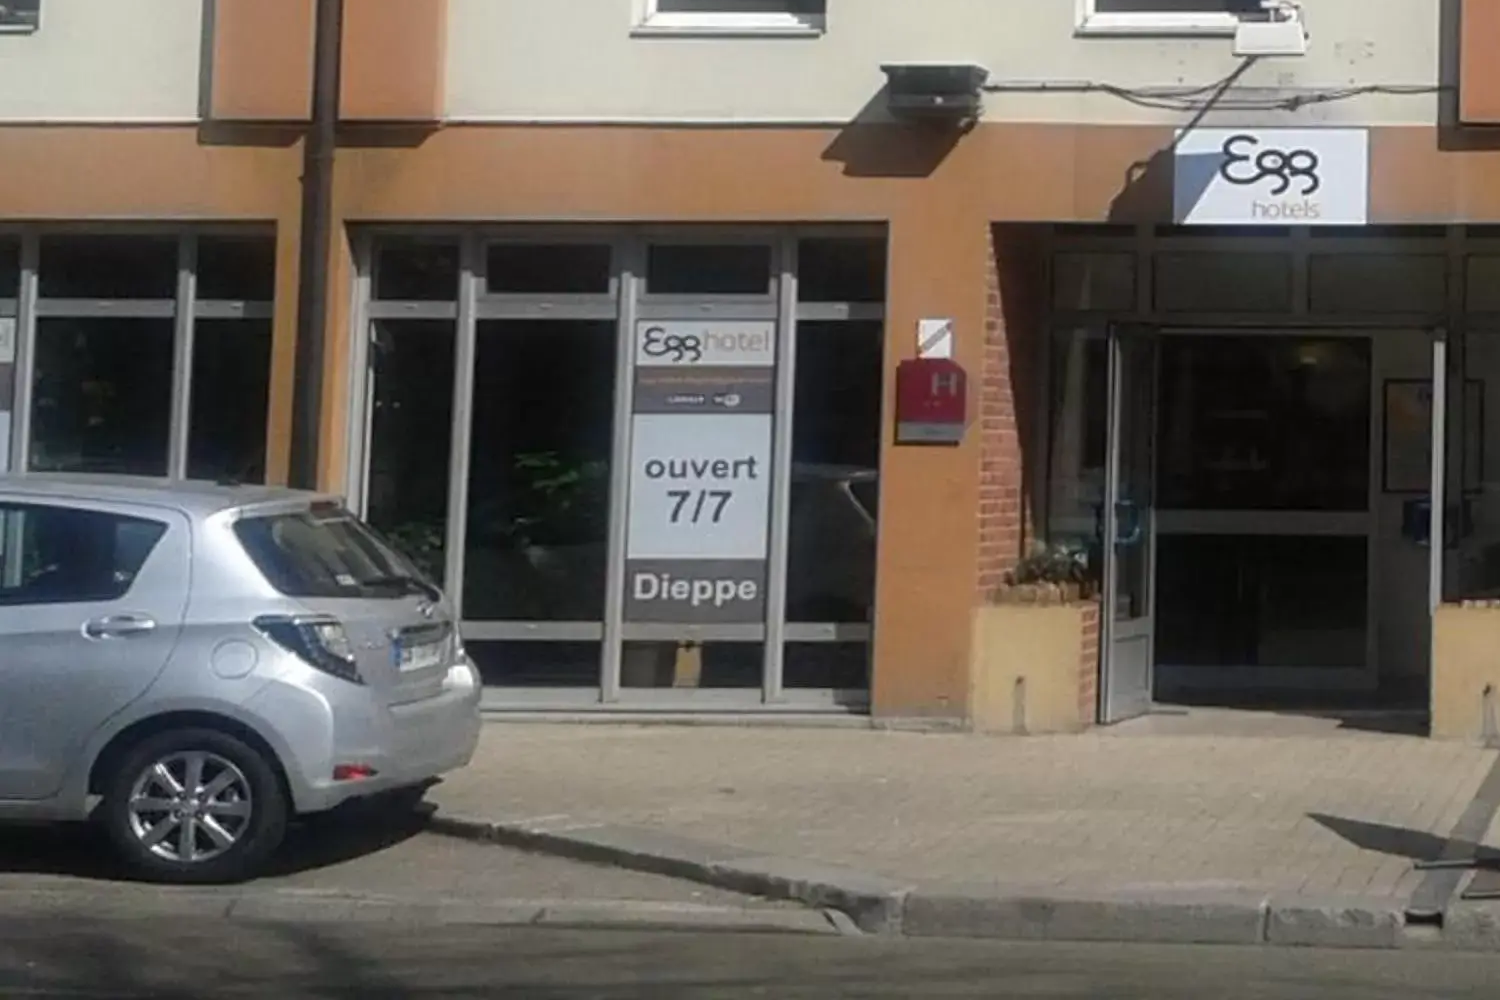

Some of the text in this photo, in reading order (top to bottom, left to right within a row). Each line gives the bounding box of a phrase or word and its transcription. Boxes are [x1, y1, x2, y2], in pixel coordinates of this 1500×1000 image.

[1220, 134, 1319, 195] Egg
[1252, 201, 1320, 219] hotels
[932, 372, 957, 396] H
[645, 456, 758, 479] ouvert
[667, 490, 732, 523] 7/7
[633, 573, 758, 606] Dieppe
